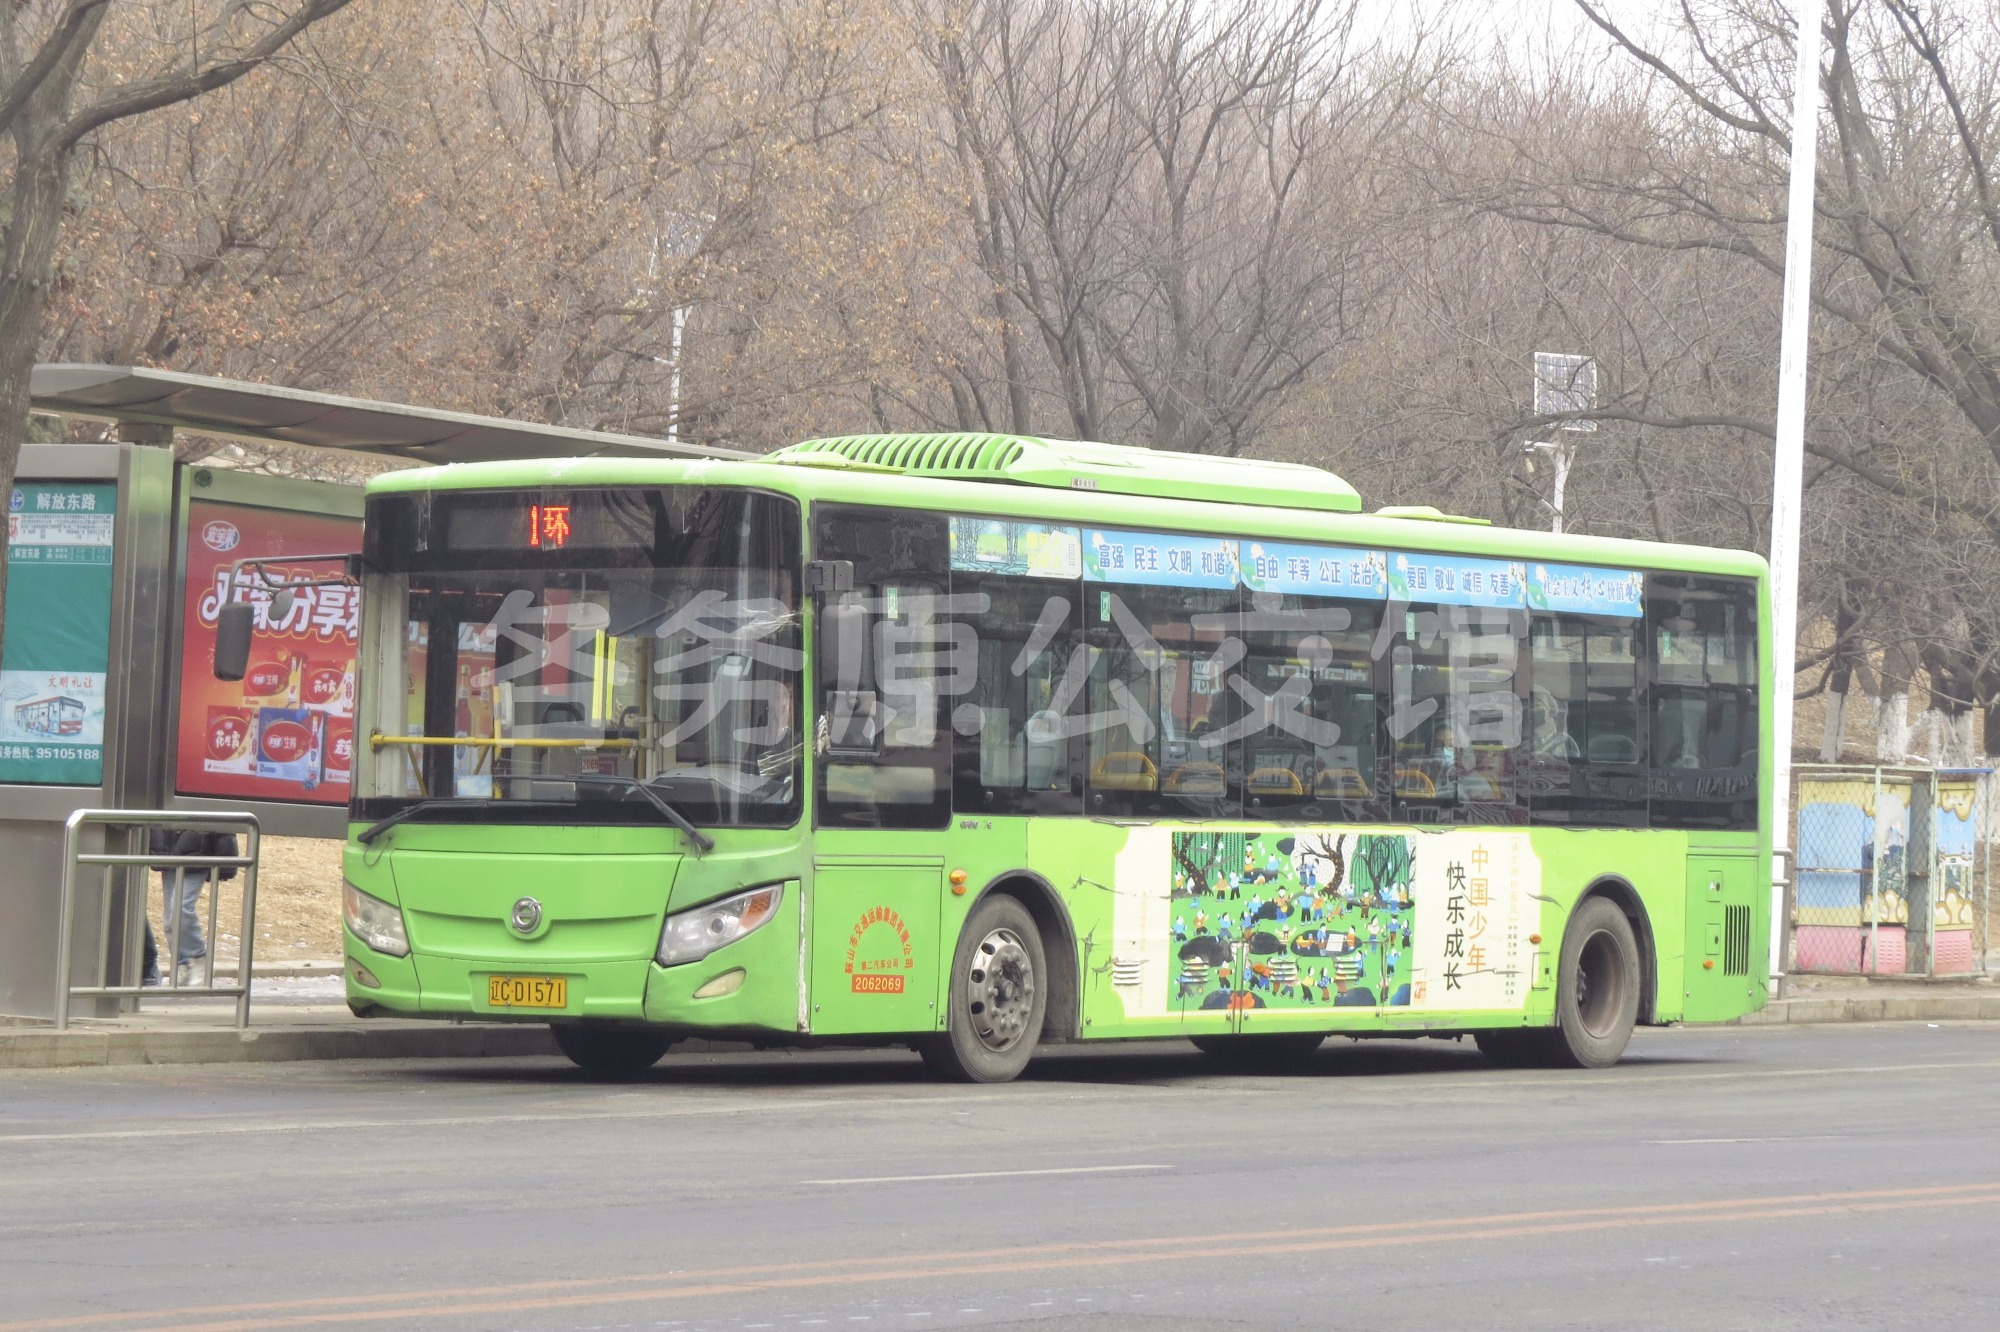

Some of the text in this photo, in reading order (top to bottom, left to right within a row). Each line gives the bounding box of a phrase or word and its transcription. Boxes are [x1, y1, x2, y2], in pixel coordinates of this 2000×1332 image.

[36, 492, 96, 511] 解放东路
[530, 505, 570, 545] 1环
[1099, 544, 1125, 570] 富强
[1134, 546, 1159, 572] 民主
[1167, 548, 1193, 574] 文明
[1201, 551, 1227, 577] 和谐
[1255, 556, 1373, 587] 自由 平等 公正 法治
[1406, 567, 1511, 596] 爱国 敬业 诚信 友善
[1543, 572, 1635, 602] 社会主义核心价值观
[48, 675, 93, 688] 文明礼让
[0, 746, 100, 760] 务热线: 95105188
[582, 758, 599, 770] 2069
[1467, 844, 1488, 973] 中国少年
[1443, 861, 1466, 991] 快乐成长
[855, 976, 901, 991] 2062069
